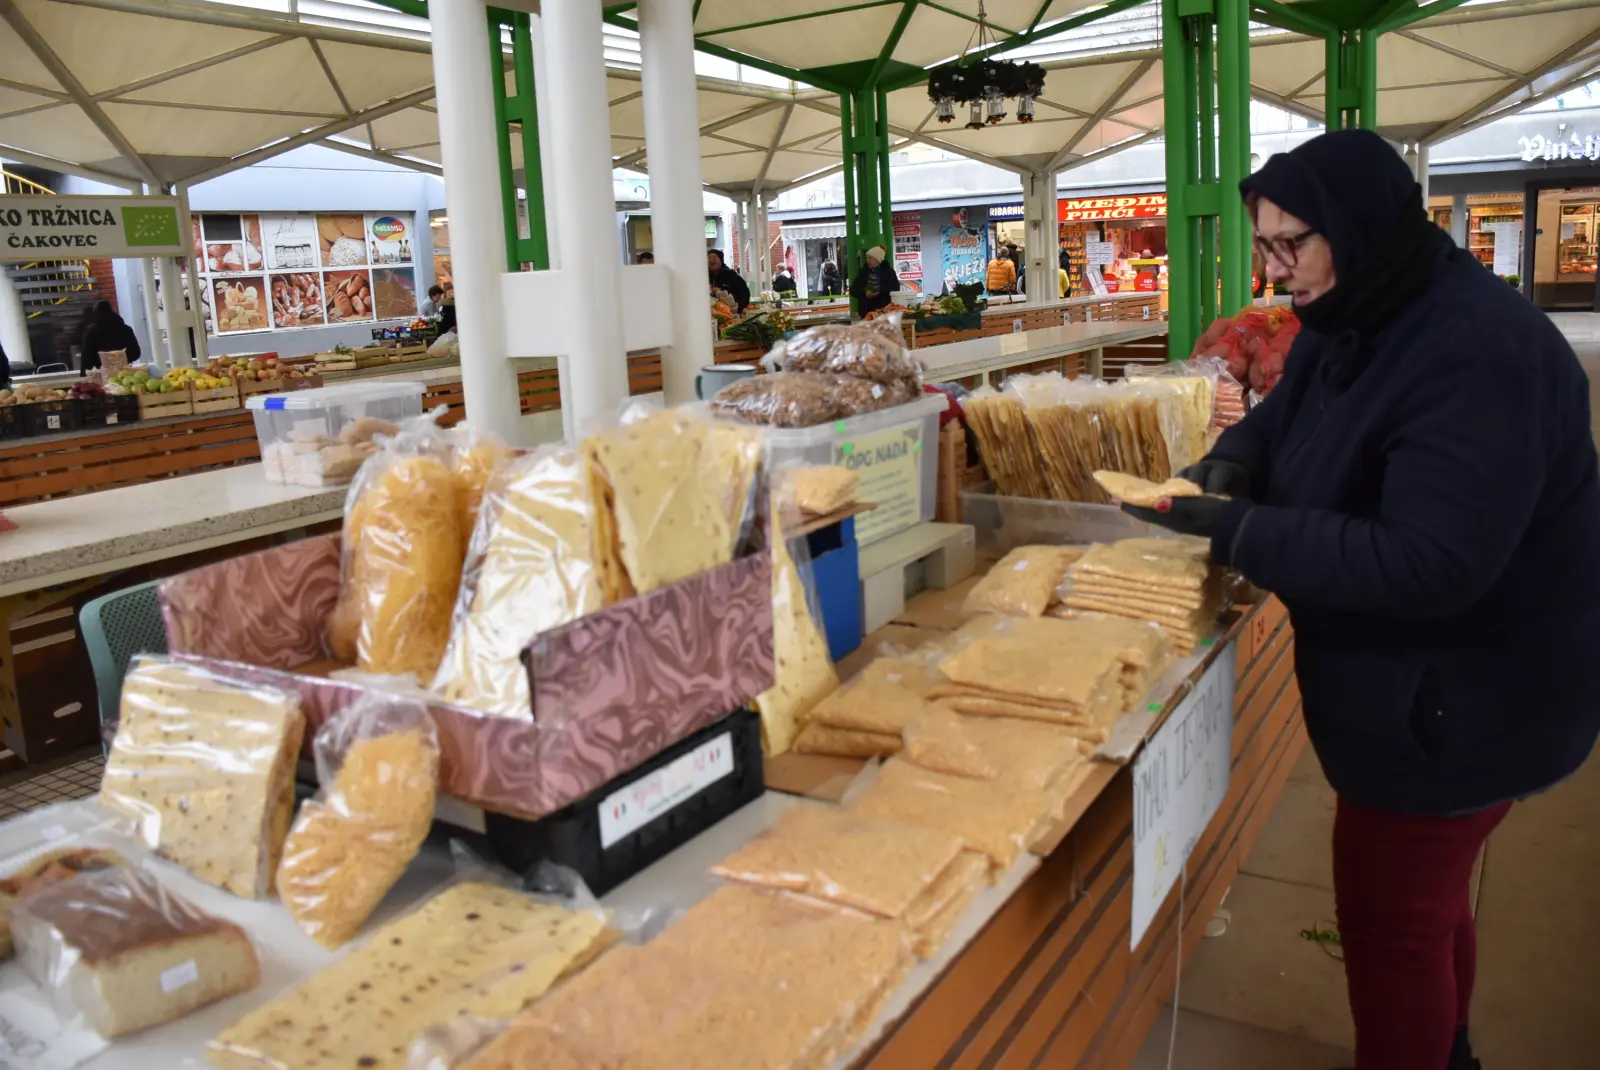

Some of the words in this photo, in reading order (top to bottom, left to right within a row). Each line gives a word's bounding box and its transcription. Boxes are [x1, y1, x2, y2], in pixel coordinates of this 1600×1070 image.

[27, 205, 117, 227] TRŽNICA
[1065, 207, 1136, 221] PILIĆI
[7, 233, 98, 249] ČAKOVEC
